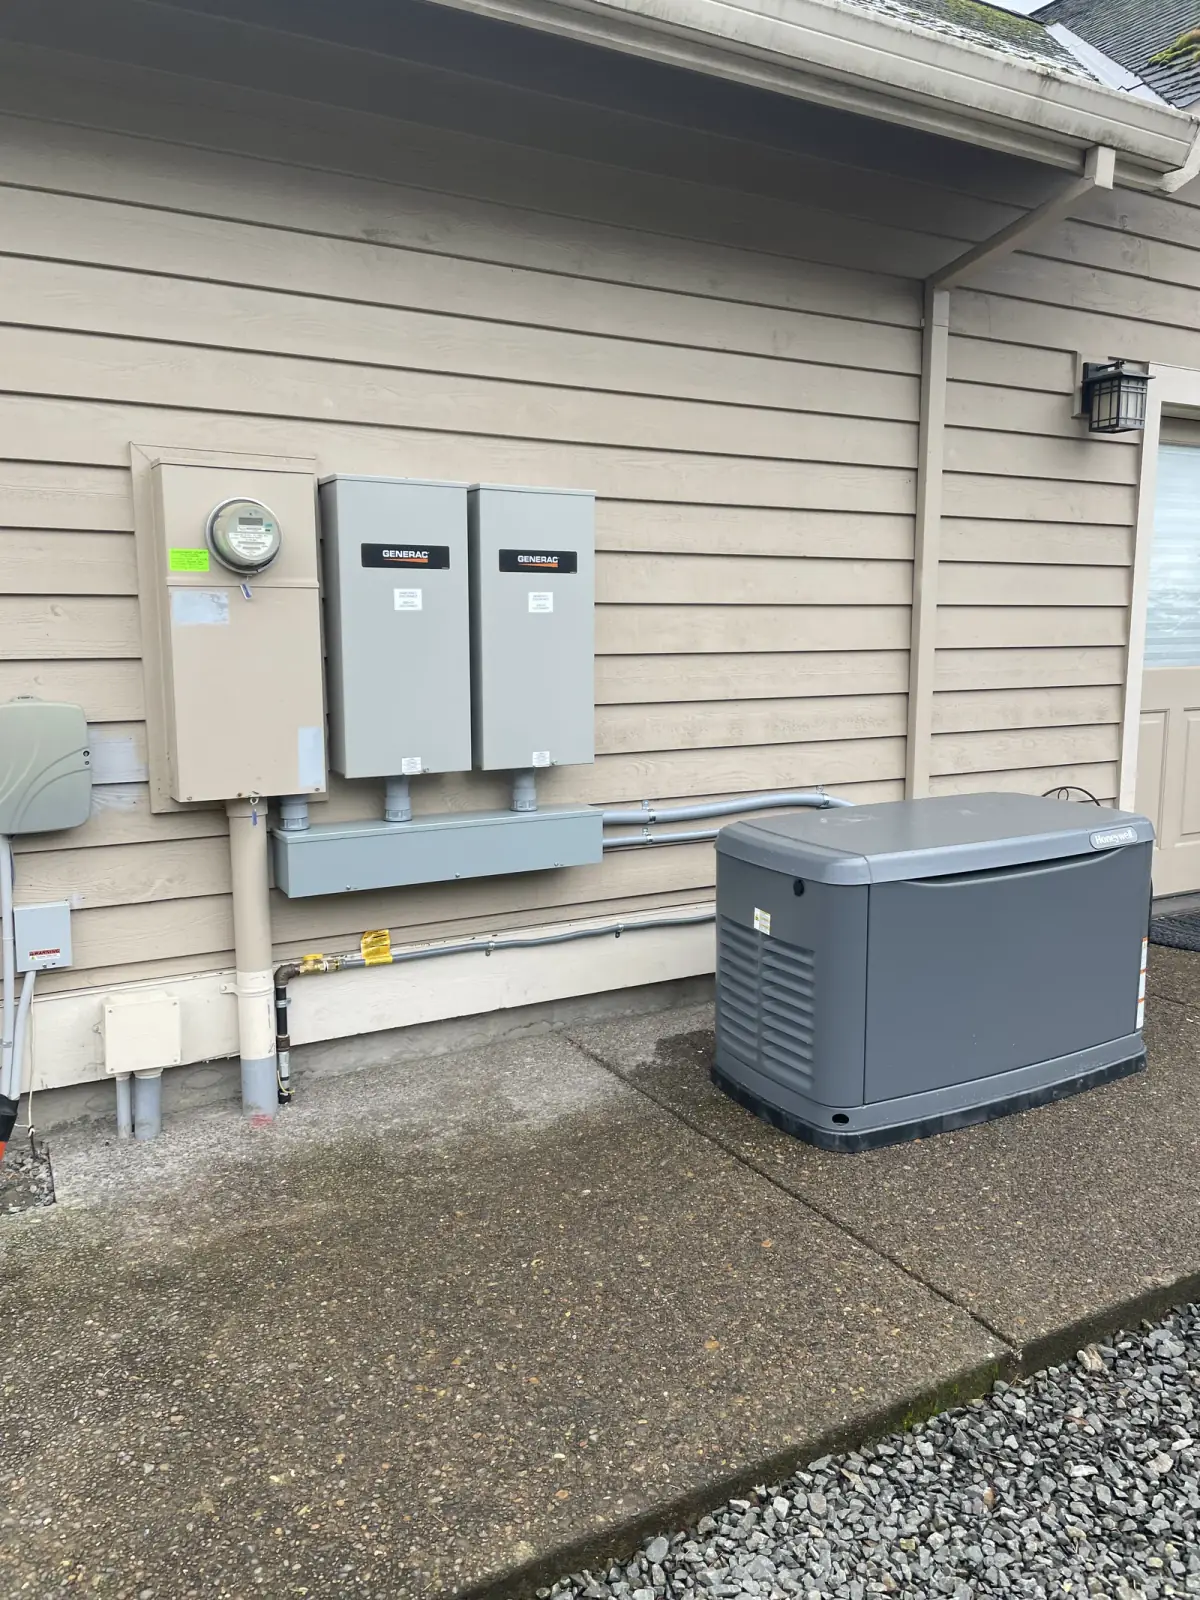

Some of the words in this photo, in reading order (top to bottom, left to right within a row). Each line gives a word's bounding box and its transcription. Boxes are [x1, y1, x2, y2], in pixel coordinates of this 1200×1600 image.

[382, 549, 429, 559] GENERAC
[517, 555, 558, 563] GENERAC
[1094, 829, 1134, 845] Honeywell
